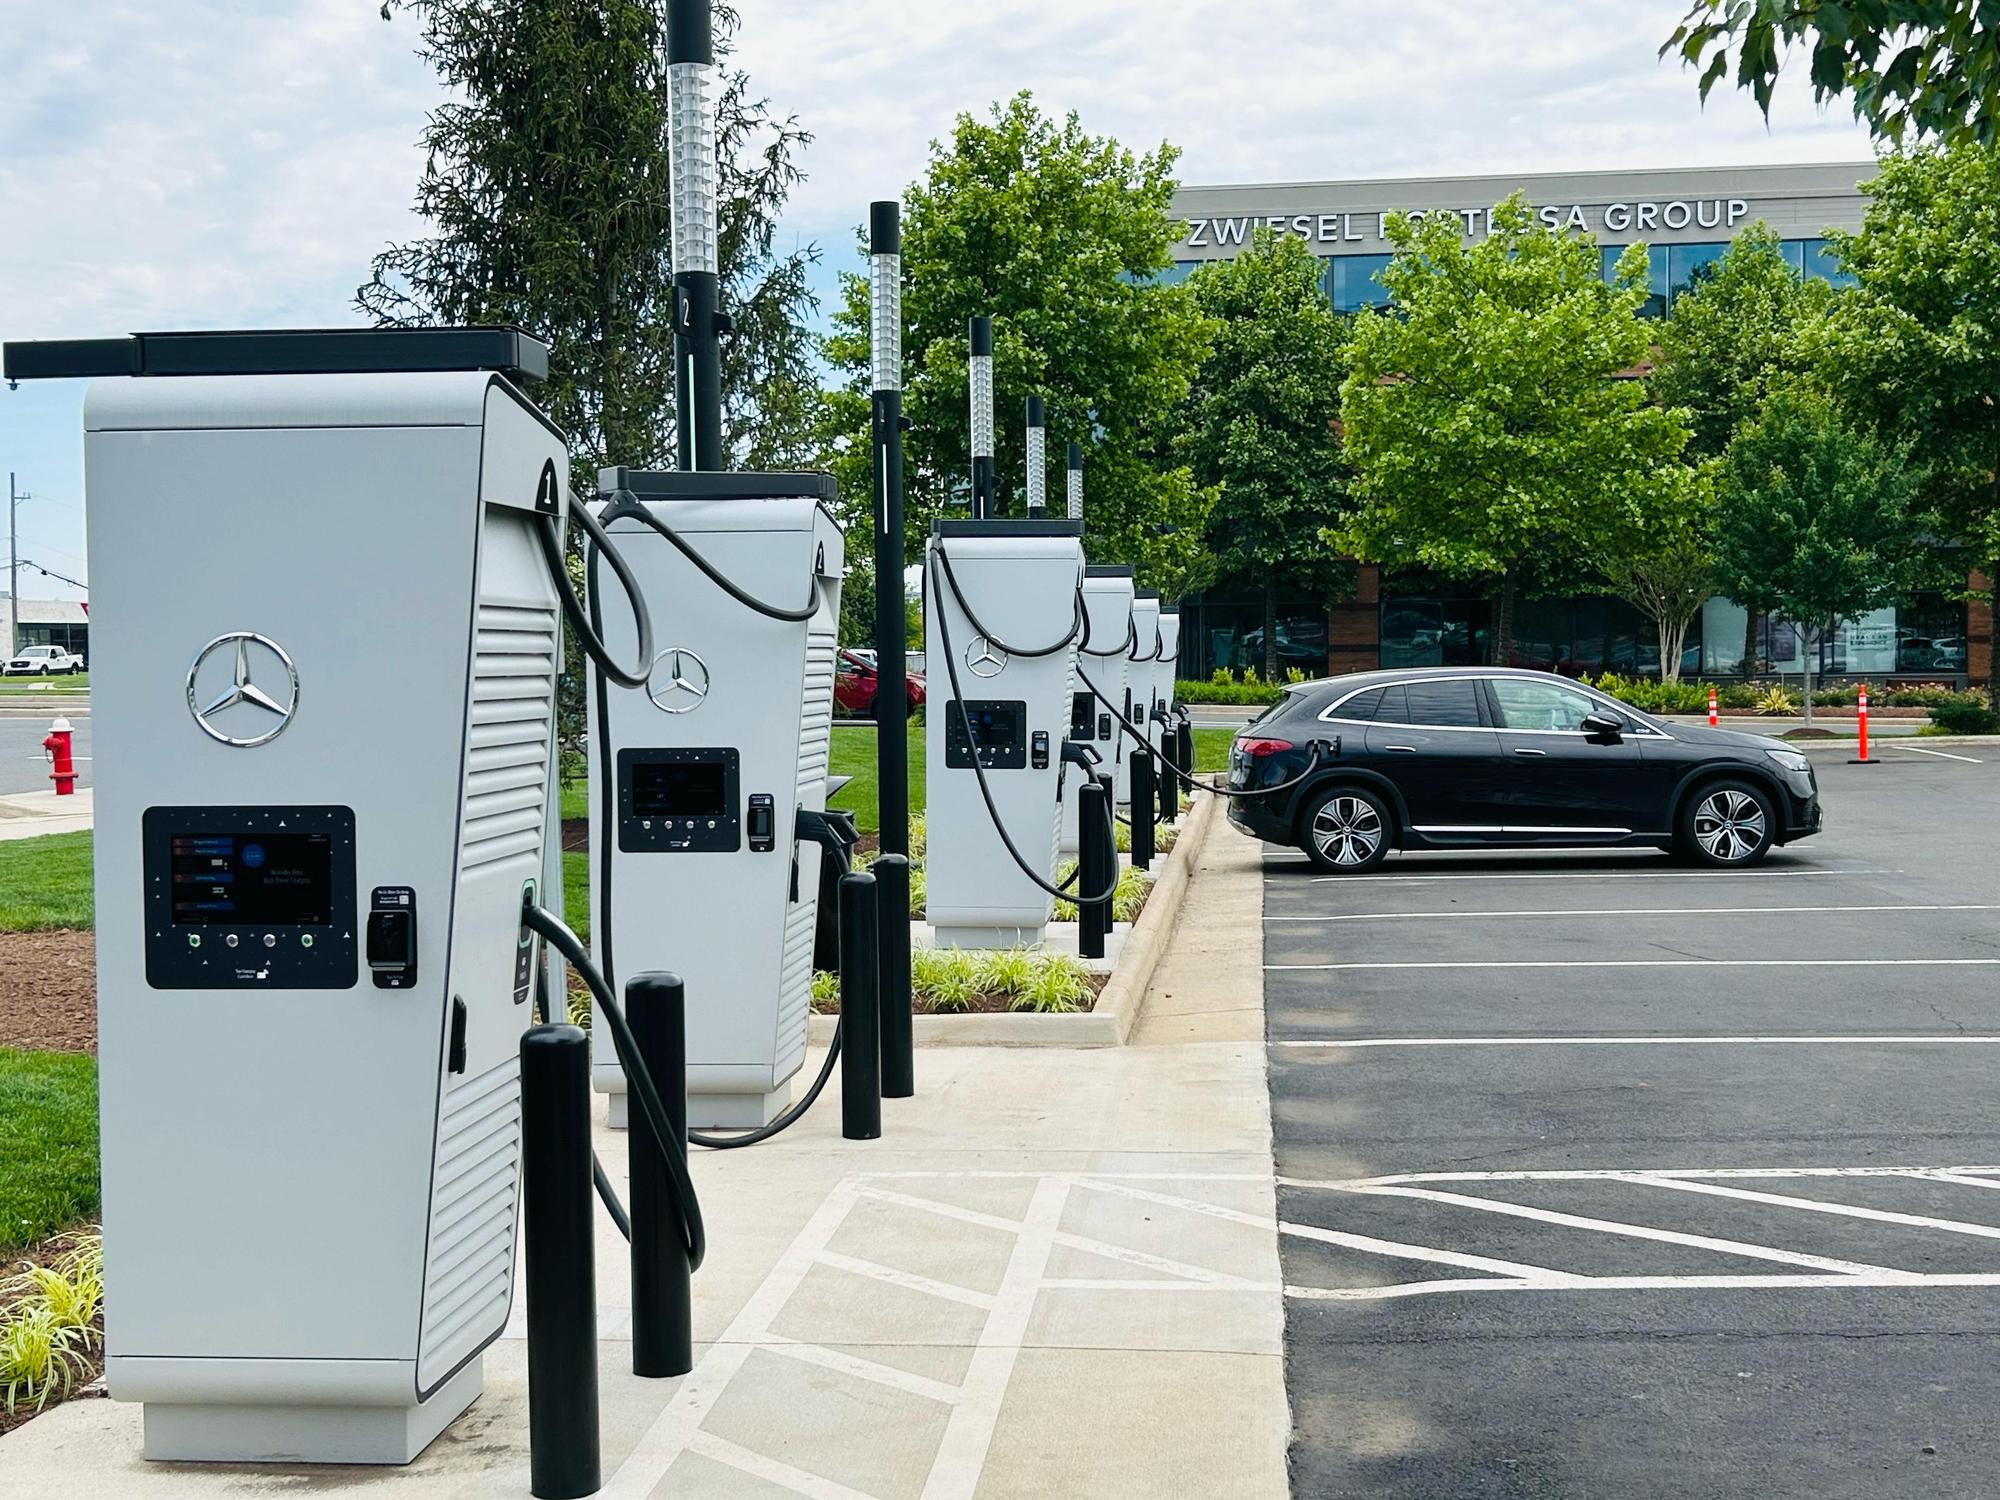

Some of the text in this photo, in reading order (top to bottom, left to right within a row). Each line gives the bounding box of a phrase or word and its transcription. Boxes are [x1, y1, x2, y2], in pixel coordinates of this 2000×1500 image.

[1187, 214, 1363, 246] ZWIESEL
[1604, 199, 1749, 231] GROUP
[682, 297, 691, 327] 2
[543, 471, 552, 504] 1
[817, 547, 823, 569] 2
